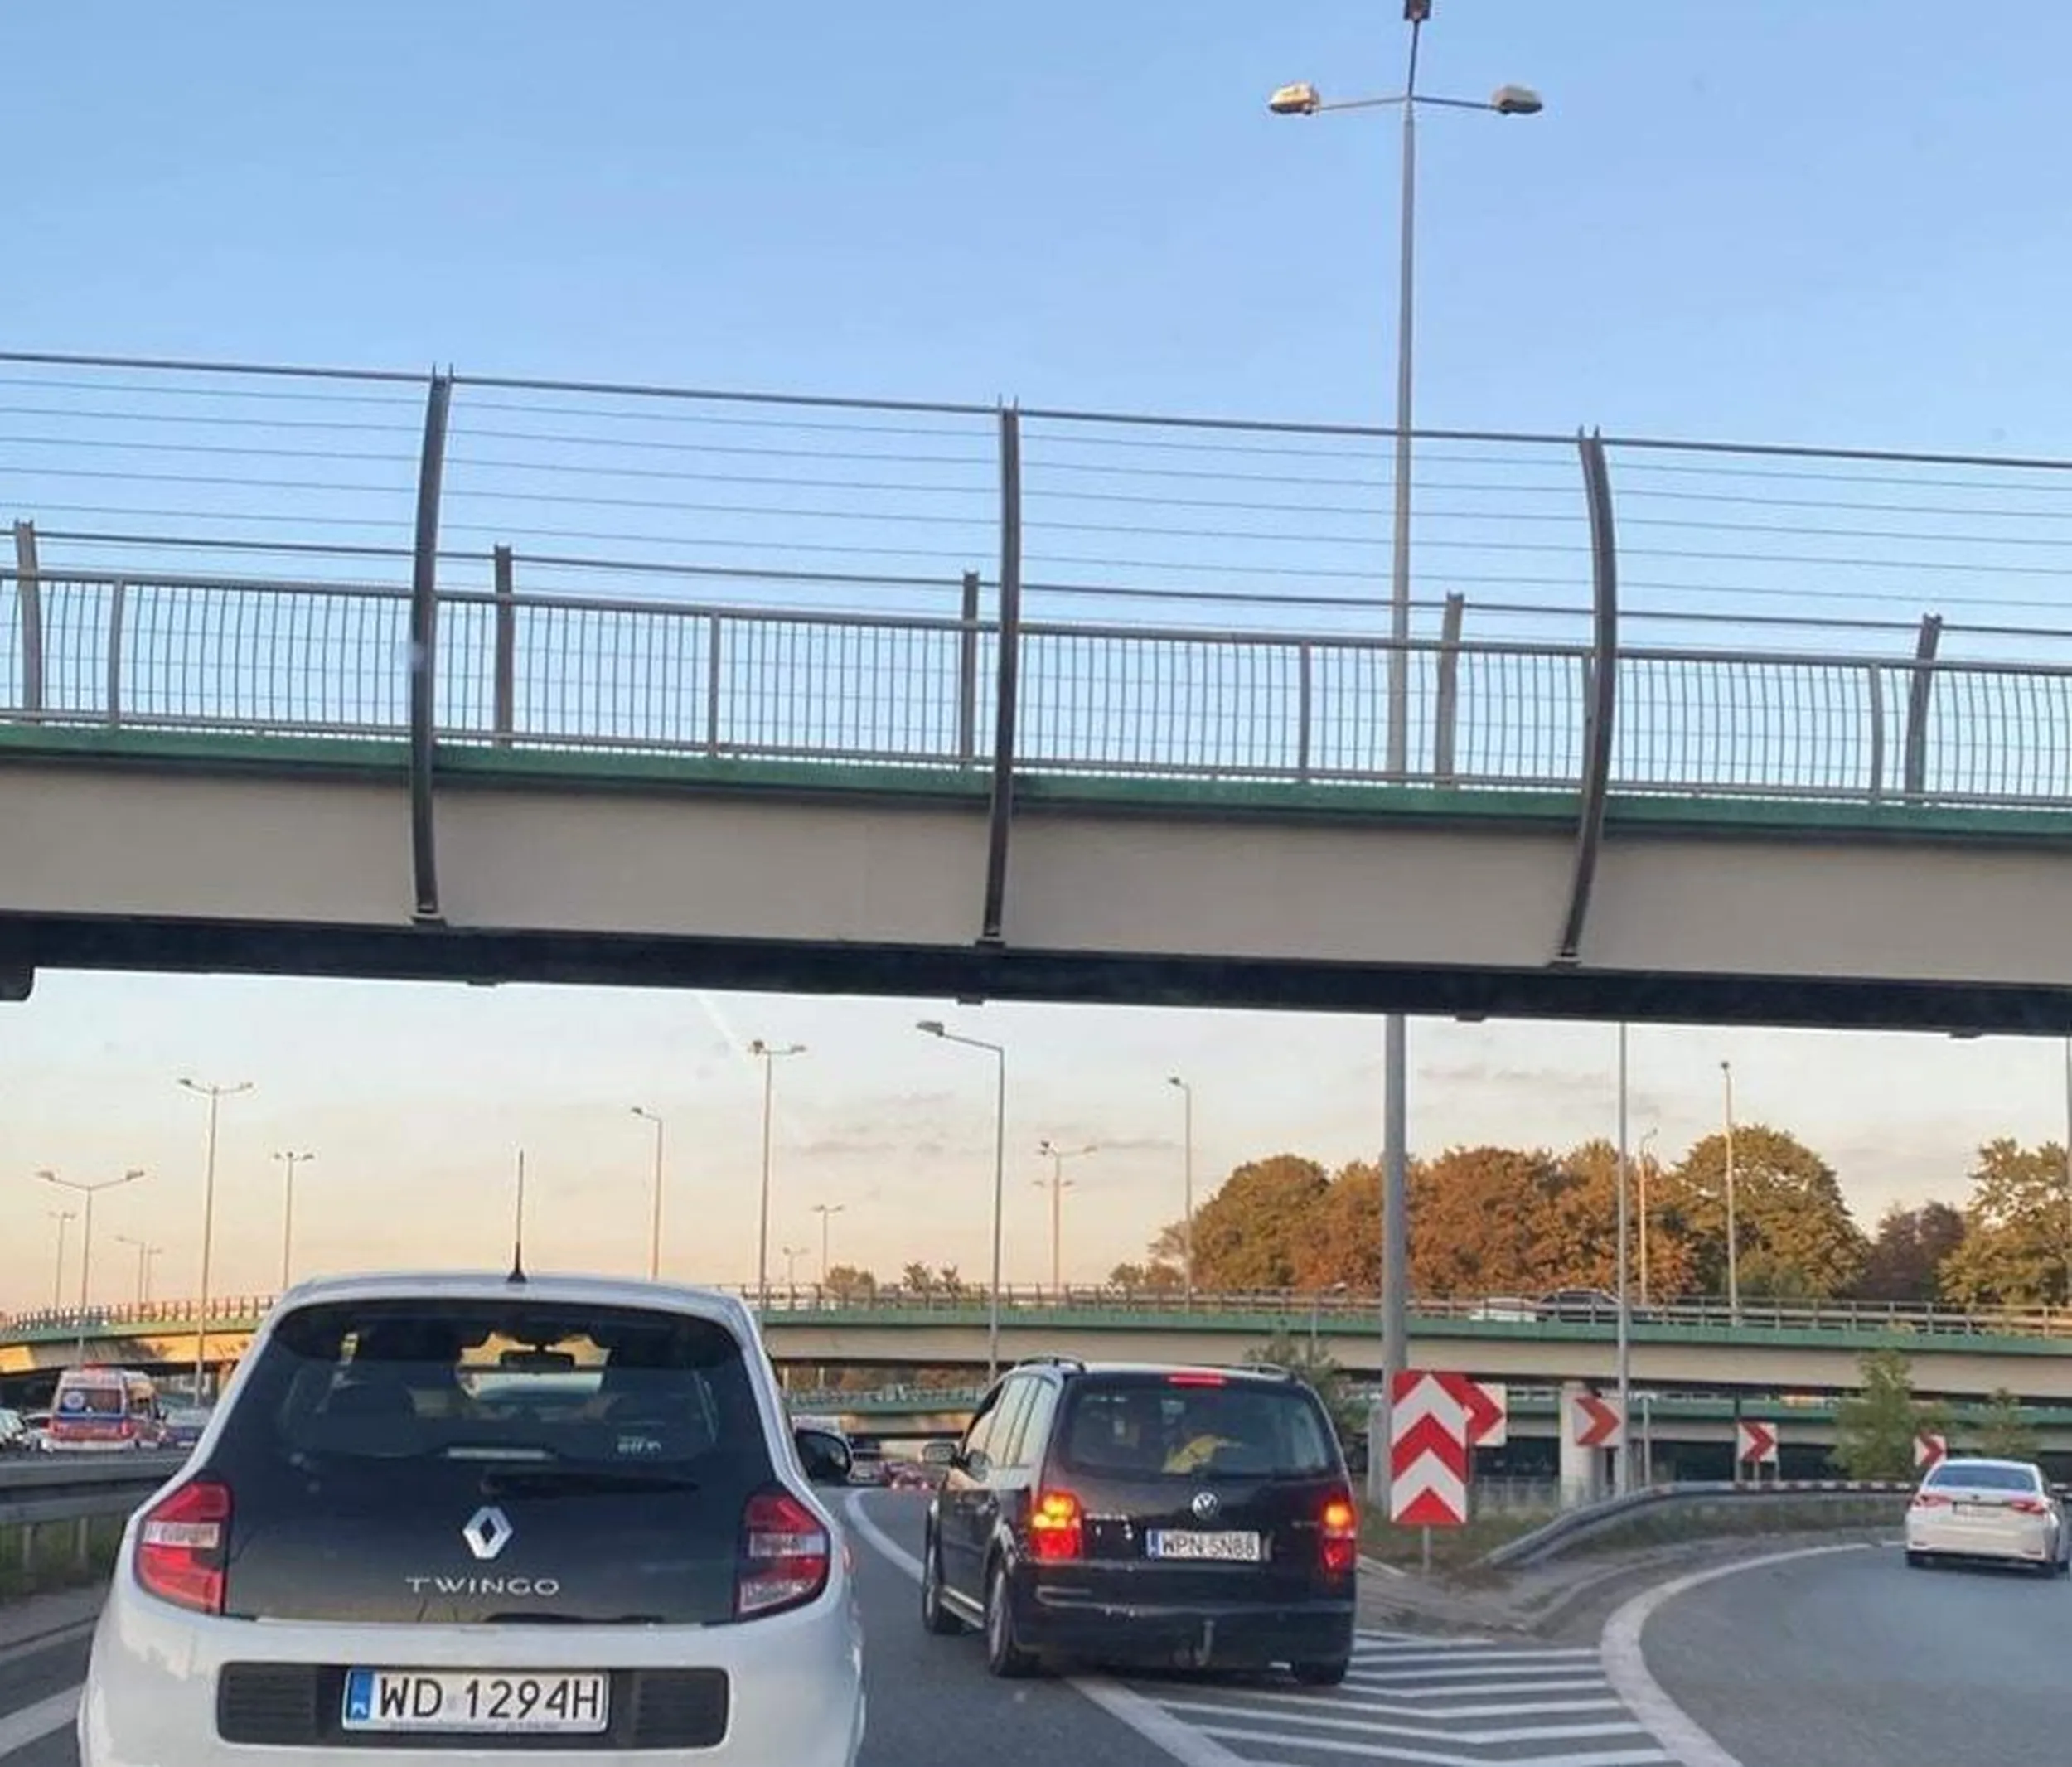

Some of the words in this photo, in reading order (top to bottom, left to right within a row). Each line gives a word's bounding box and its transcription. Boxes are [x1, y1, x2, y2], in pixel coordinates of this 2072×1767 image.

[404, 1576, 560, 1596] TWINGO
[380, 1677, 443, 1719] WD
[465, 1678, 599, 1720] 1294H
